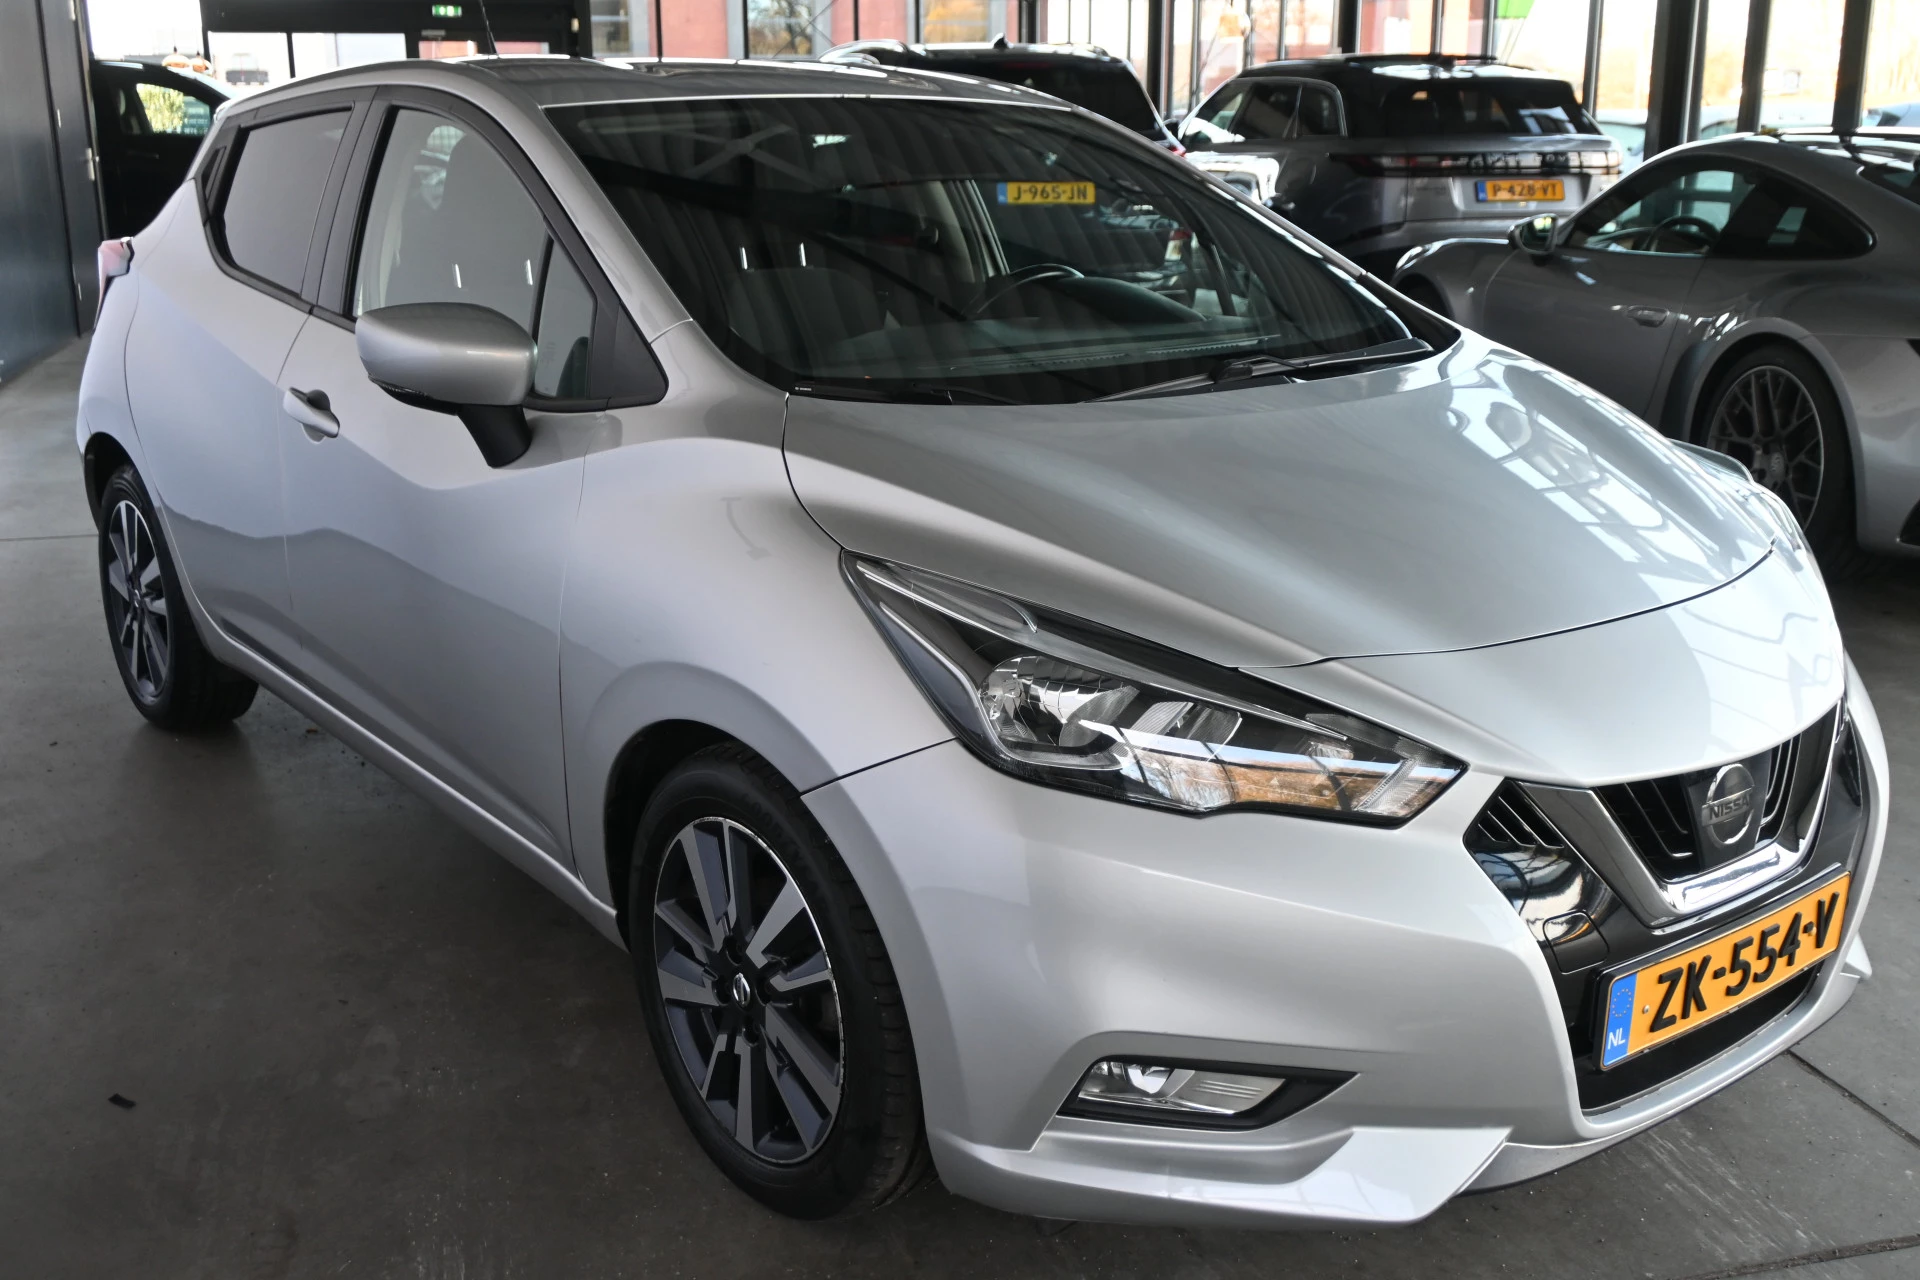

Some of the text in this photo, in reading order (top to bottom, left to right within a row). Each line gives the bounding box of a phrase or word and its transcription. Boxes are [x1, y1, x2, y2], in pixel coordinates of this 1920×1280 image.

[1013, 184, 1088, 201] J-965-JN
[1493, 183, 1557, 197] P-428-VT
[1709, 792, 1753, 820] NISSA
[1649, 892, 1840, 1033] ZK-554-V
[1607, 1027, 1626, 1050] NL
